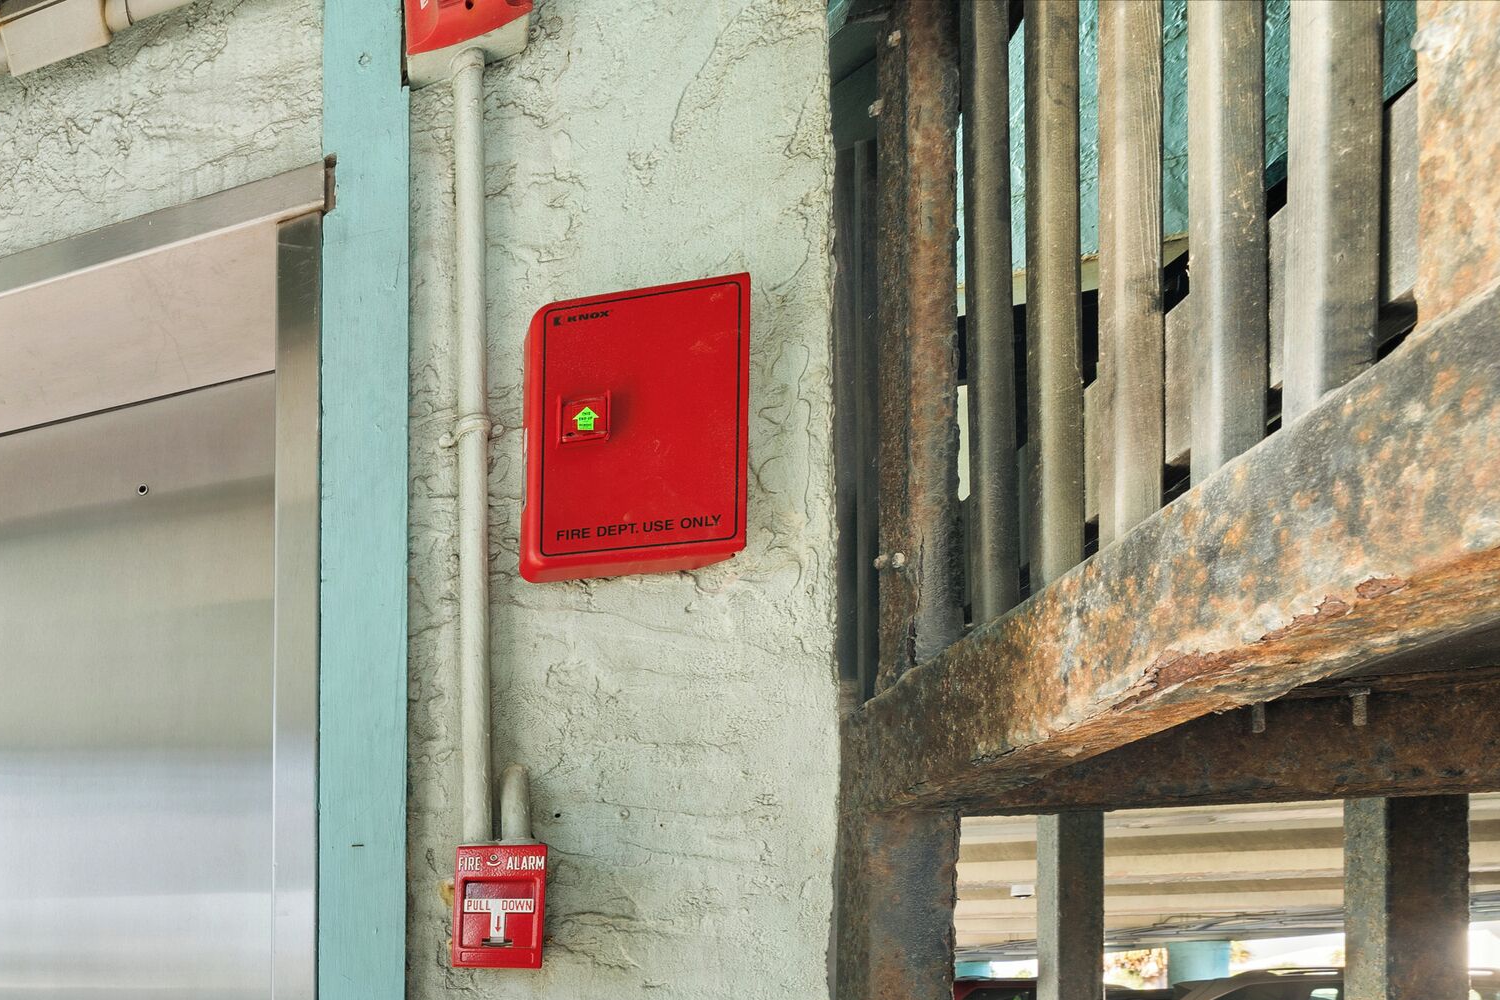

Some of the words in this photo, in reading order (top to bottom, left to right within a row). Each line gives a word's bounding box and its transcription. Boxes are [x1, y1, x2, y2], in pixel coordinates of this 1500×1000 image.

[567, 310, 609, 322] KNOX
[556, 527, 590, 541] FIRE
[596, 523, 639, 537] DEPT.
[642, 519, 674, 532] USE
[680, 514, 721, 529] ONLY
[458, 856, 480, 870] FIRE
[506, 856, 545, 870] ALARM
[466, 900, 490, 910] PULL
[502, 900, 532, 910] DOWN
